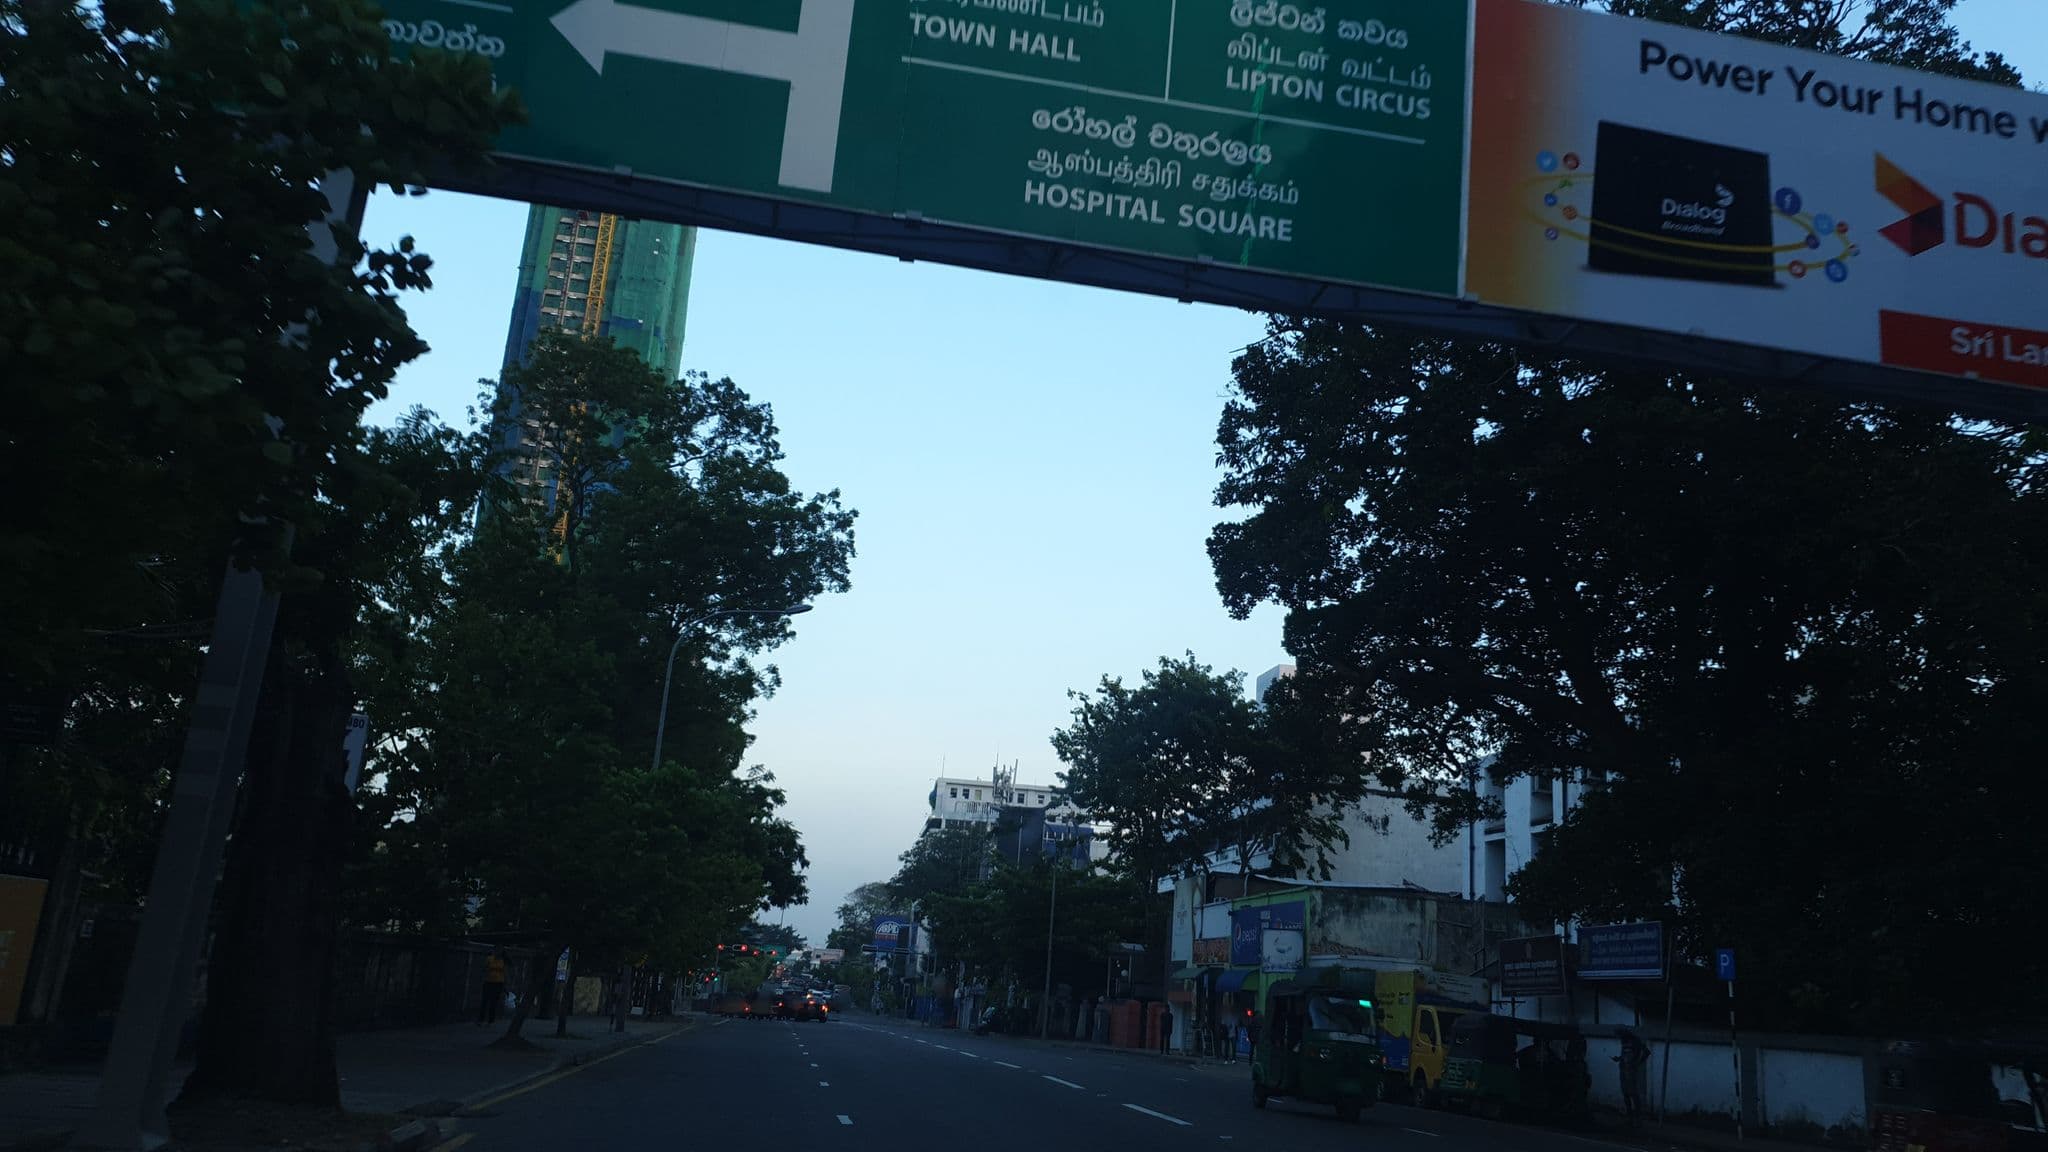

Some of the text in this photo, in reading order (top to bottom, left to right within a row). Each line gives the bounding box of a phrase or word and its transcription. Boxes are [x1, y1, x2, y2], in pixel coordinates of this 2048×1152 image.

[909, 11, 1080, 62] TOWN HALL
[1227, 32, 1431, 91] லிப்டன் வட்டம்
[1226, 66, 1432, 120] LIPTON CIRCUS
[1640, 40, 1774, 95] Power
[1785, 66, 1883, 115] Your
[1895, 86, 2017, 138] Home
[1032, 106, 1137, 149] රෝහල්
[1027, 148, 1299, 206] ஆஸ்பத்திரி சதுக்கம்
[1024, 179, 1293, 242] HOSPITAL SQUARE
[1661, 198, 1727, 225] Dialog
[1951, 326, 1996, 360] Sri
[1720, 953, 1731, 977] P
